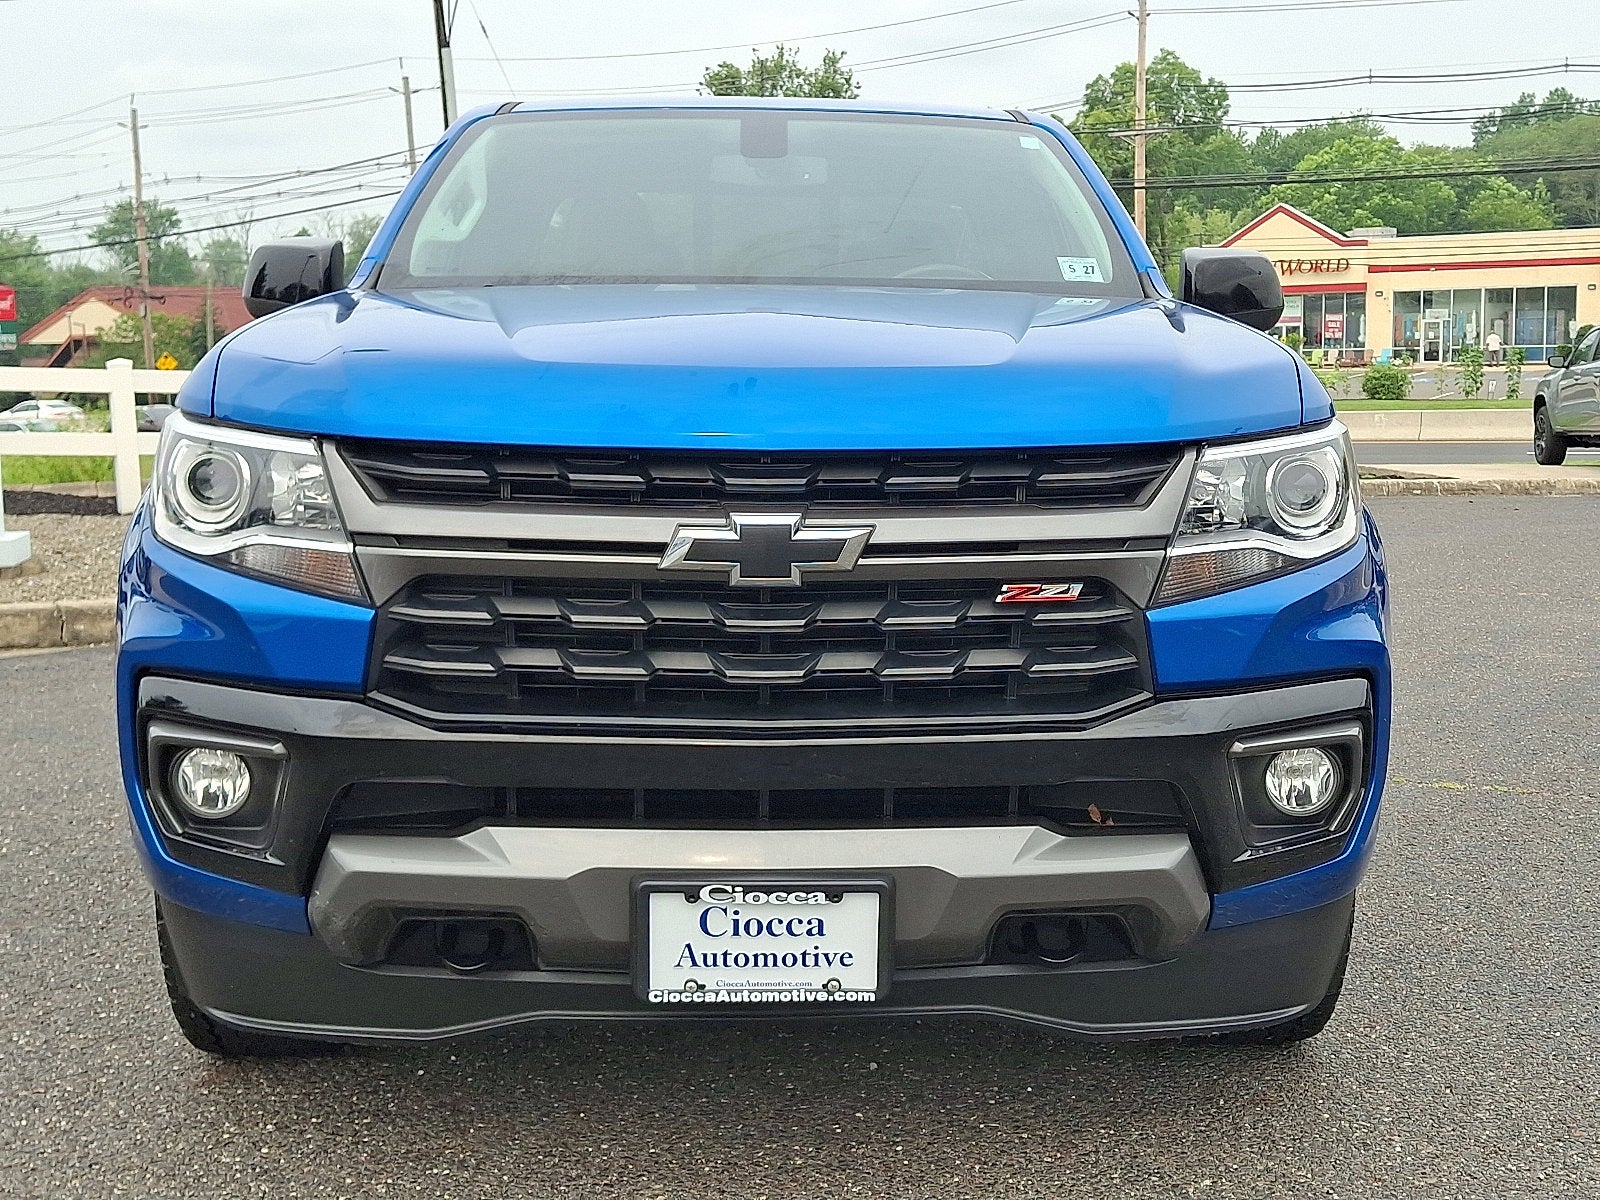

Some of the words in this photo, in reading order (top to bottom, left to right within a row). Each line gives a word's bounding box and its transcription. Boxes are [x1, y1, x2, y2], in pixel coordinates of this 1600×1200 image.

[1068, 264, 1076, 273] 5
[1082, 265, 1095, 275] 27
[1278, 258, 1350, 276] WORLD
[995, 582, 1084, 602] Z71
[699, 884, 828, 905] Ciocca
[699, 905, 826, 937] Ciocca
[674, 943, 854, 968] Automotive
[716, 979, 812, 988] CioccaAutomotive.com
[648, 989, 876, 1003] CioccaAutomotive.com
